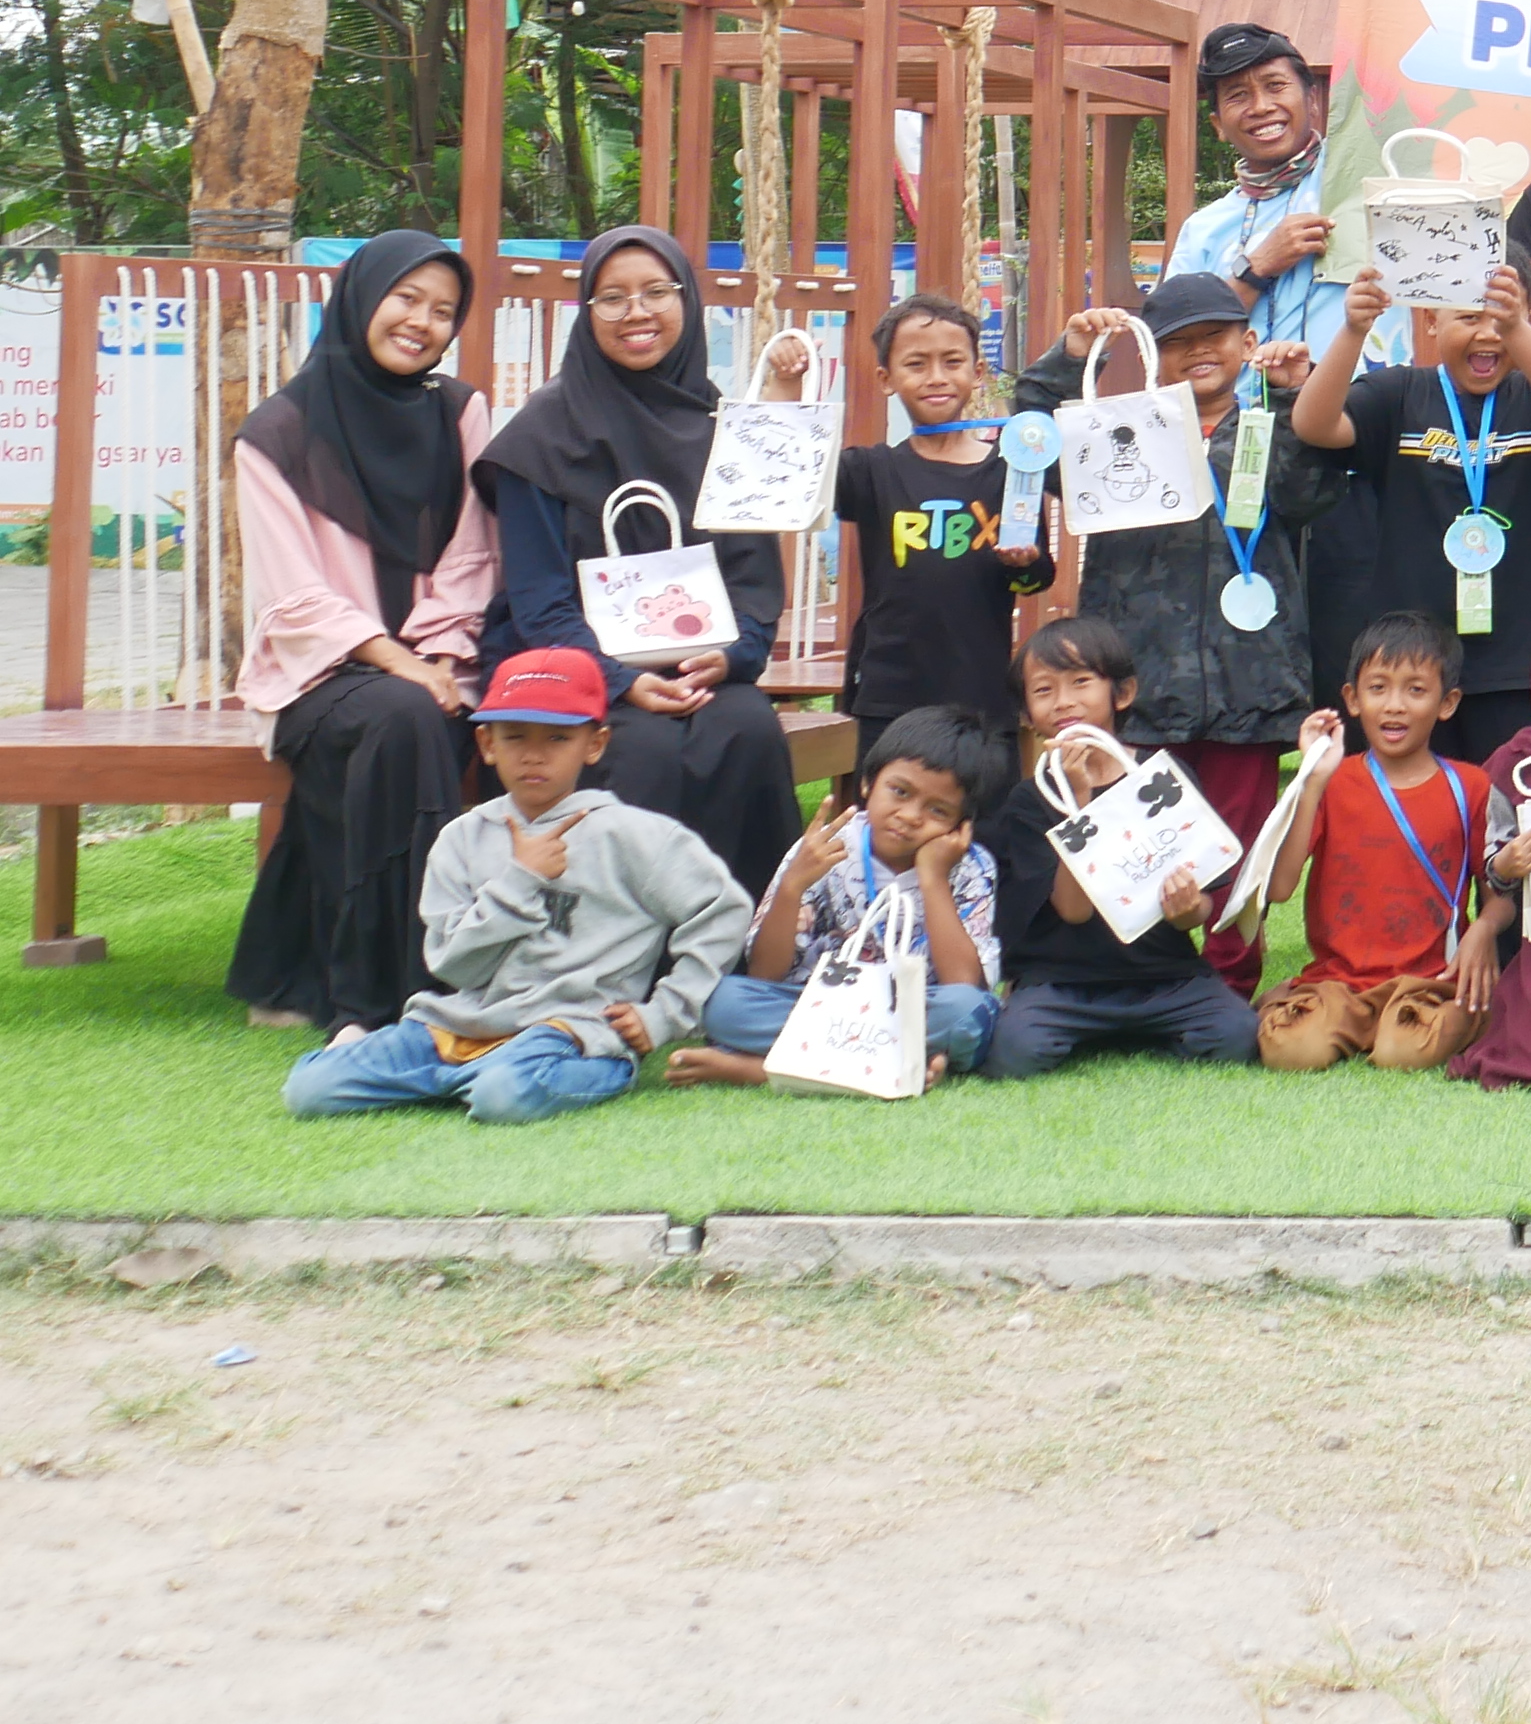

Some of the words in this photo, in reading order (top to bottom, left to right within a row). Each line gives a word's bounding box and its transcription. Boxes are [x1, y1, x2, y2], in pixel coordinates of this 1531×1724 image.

[603, 571, 643, 596] cute
[1113, 827, 1178, 877] HELLO
[829, 1017, 891, 1046] HELLO
